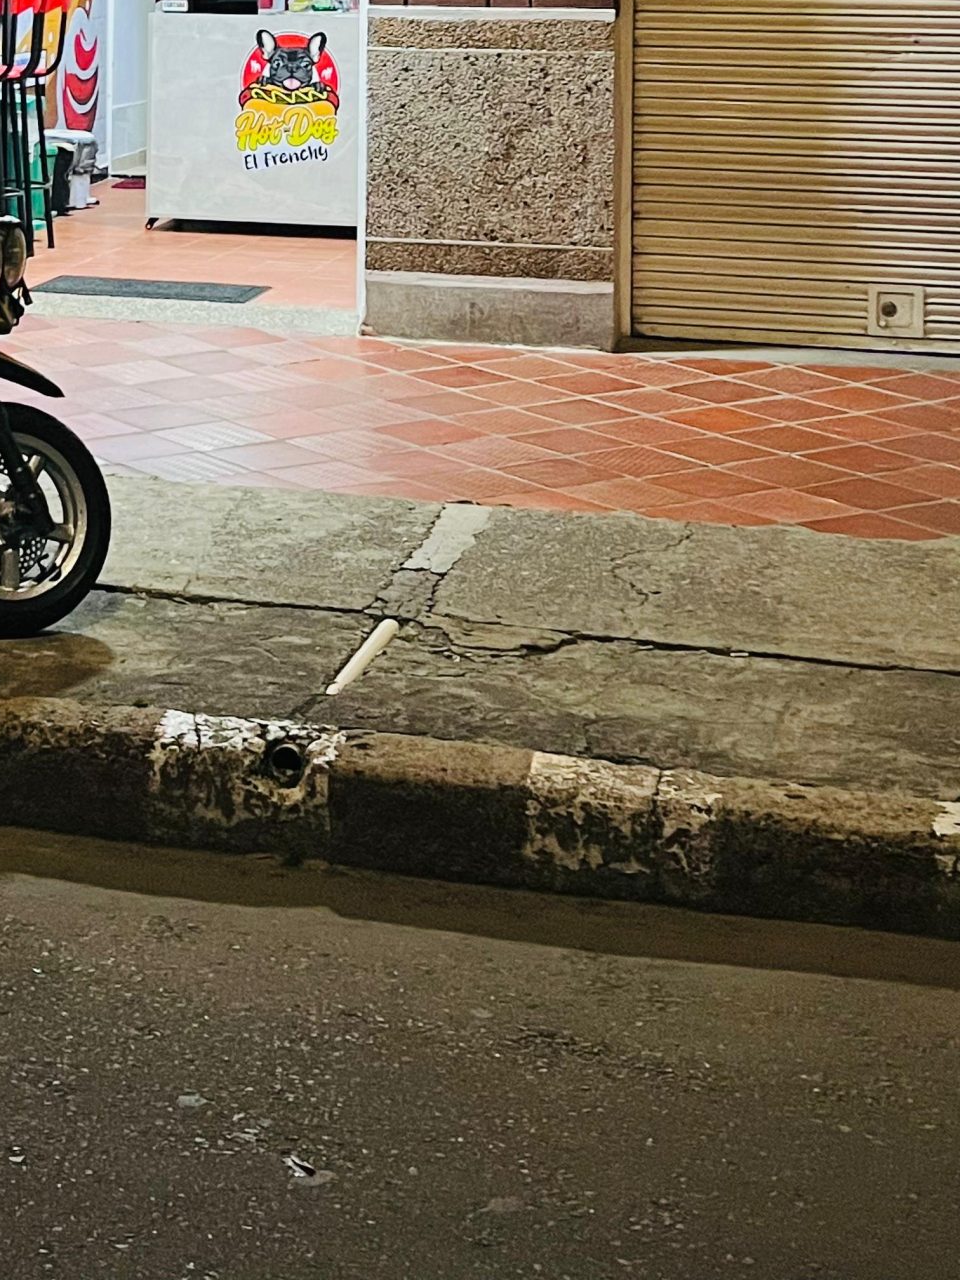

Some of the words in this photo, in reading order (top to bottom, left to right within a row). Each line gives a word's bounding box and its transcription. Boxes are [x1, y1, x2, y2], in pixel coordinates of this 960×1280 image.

[236, 111, 284, 151] Hot
[283, 106, 339, 147] Dog
[244, 154, 257, 170] El
[264, 146, 328, 168] Frenchy
